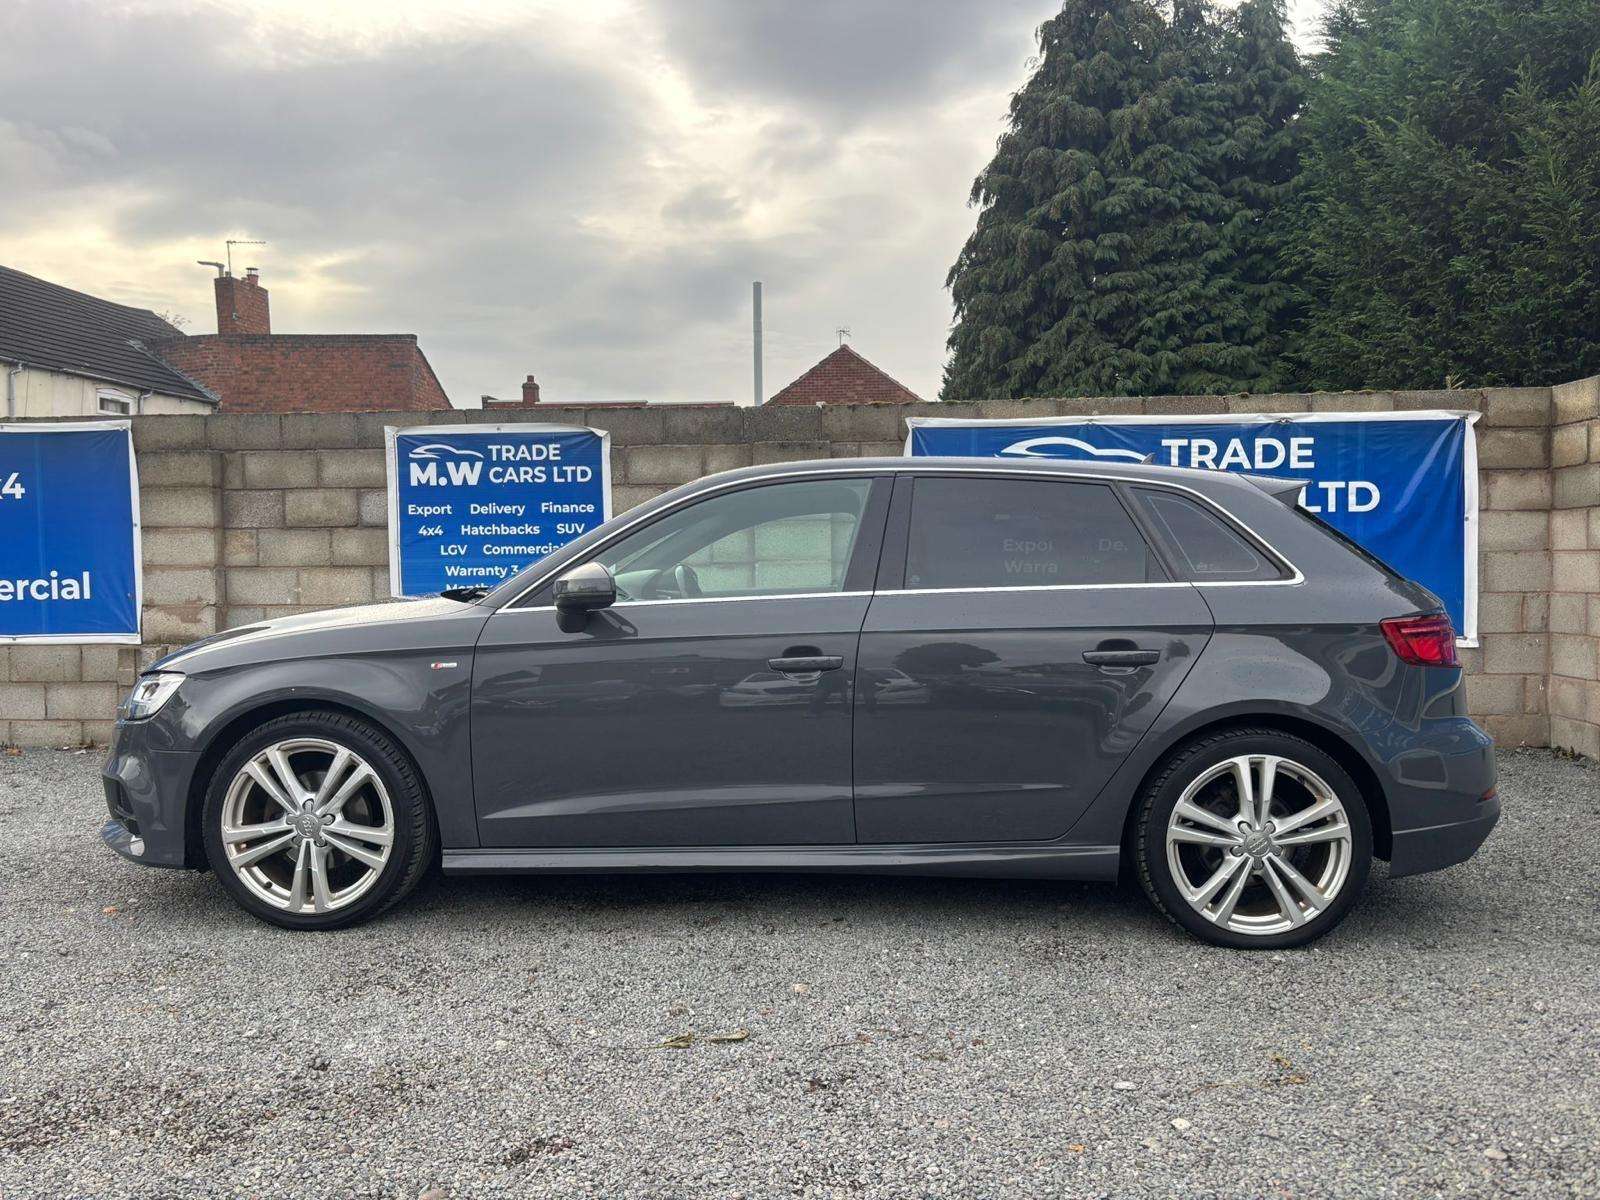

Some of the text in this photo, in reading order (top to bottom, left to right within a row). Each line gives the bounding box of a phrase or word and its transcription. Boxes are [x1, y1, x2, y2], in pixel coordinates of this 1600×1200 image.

[488, 444, 561, 461] TRADE
[1161, 437, 1315, 470] TRADE
[409, 461, 484, 487] M.W
[489, 465, 593, 484] CARS LTD
[0, 472, 26, 499] 4
[1297, 481, 1381, 513] LTD
[408, 501, 595, 518] Export Delivery Finance
[418, 523, 585, 536] 4x4 Hatchbacks SUV
[440, 542, 564, 556] LGV Commerci
[445, 565, 508, 579] Warranty
